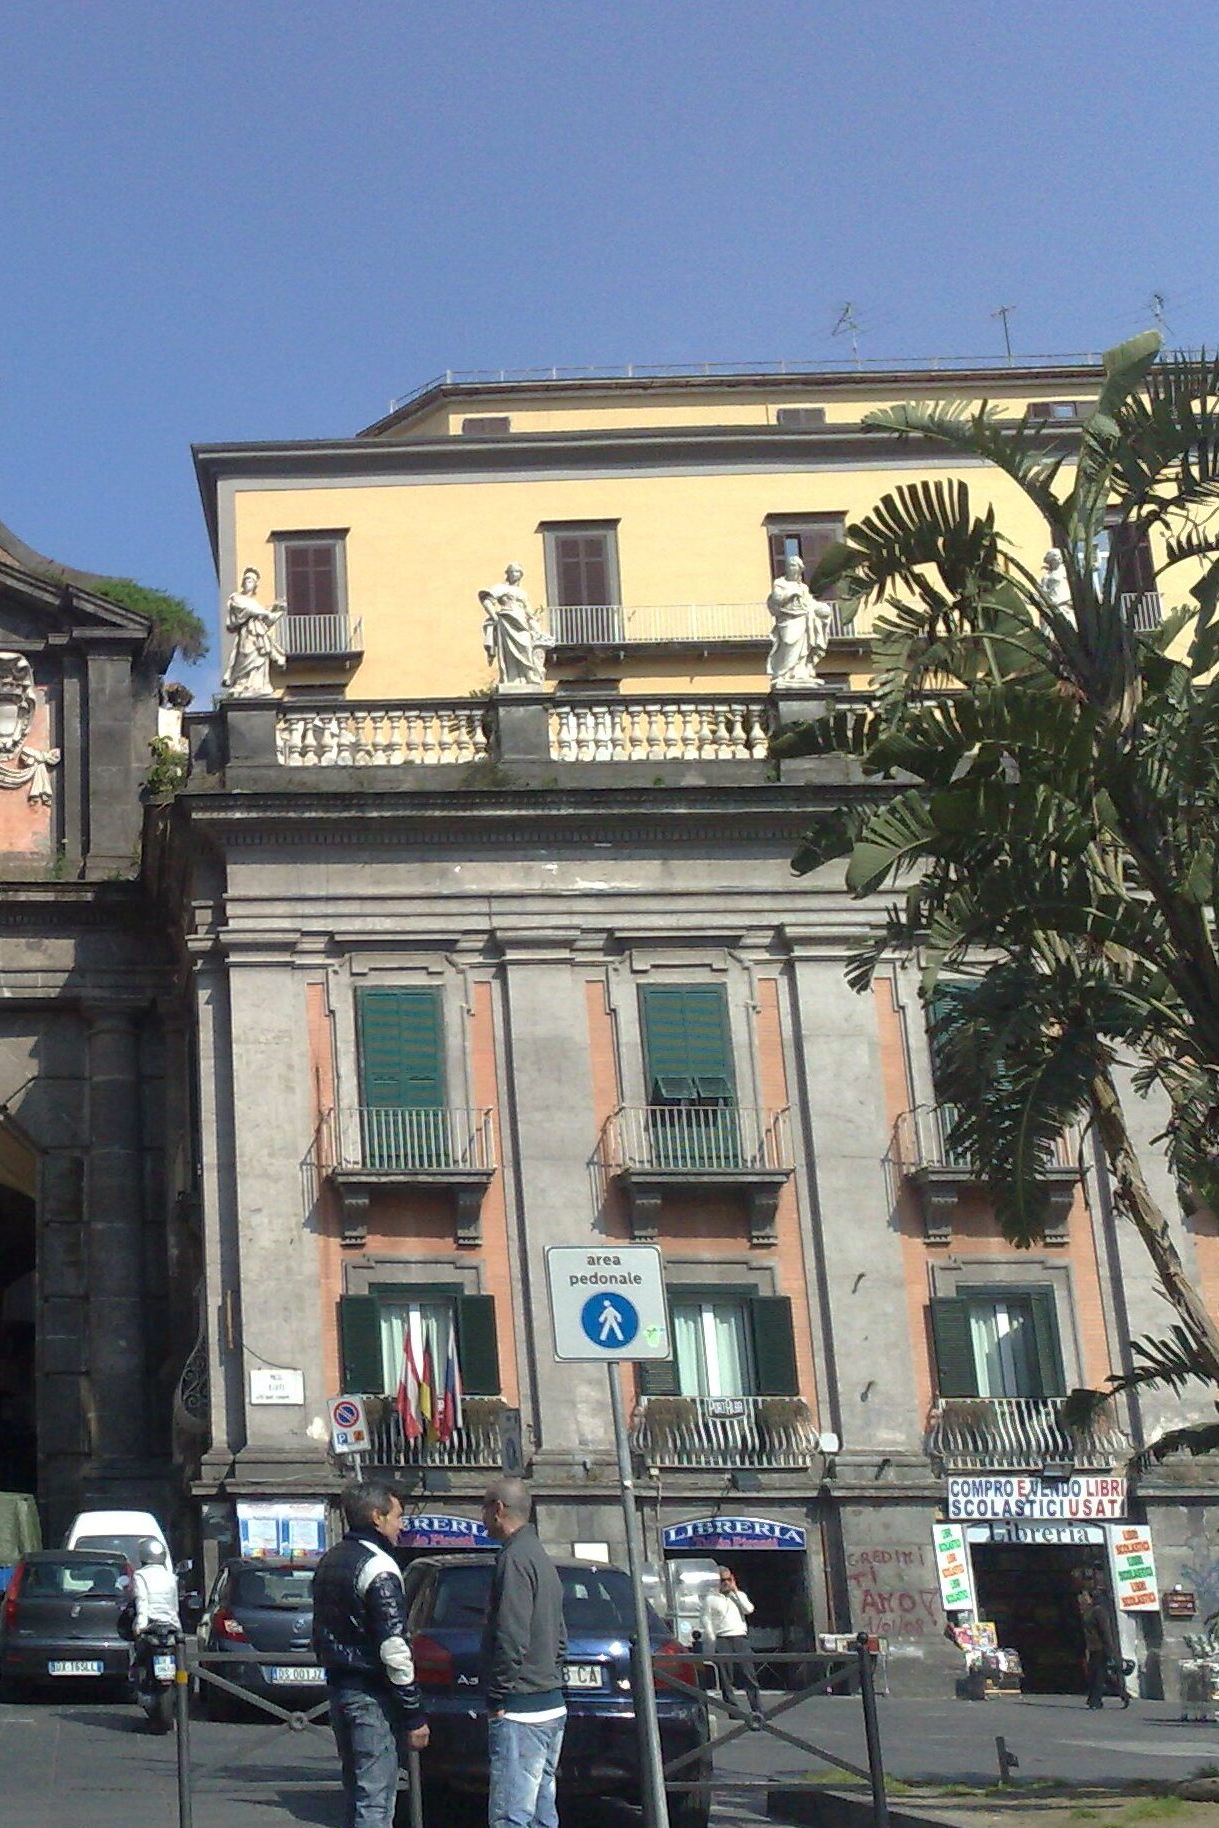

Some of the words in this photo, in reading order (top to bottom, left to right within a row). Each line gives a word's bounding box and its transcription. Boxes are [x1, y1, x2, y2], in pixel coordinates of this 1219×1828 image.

[586, 1255, 621, 1266] area
[569, 1272, 642, 1287] pedonale
[950, 1479, 1014, 1498] COMPRO
[1017, 1479, 1027, 1497] E
[1085, 1479, 1126, 1498] LIBRI
[951, 1499, 1064, 1517] SCOLASTICI
[1068, 1499, 1125, 1517] USATI
[668, 1521, 805, 1545] LIBRERIA
[988, 1521, 1091, 1544] Libreria
[577, 1666, 598, 1684] CA
